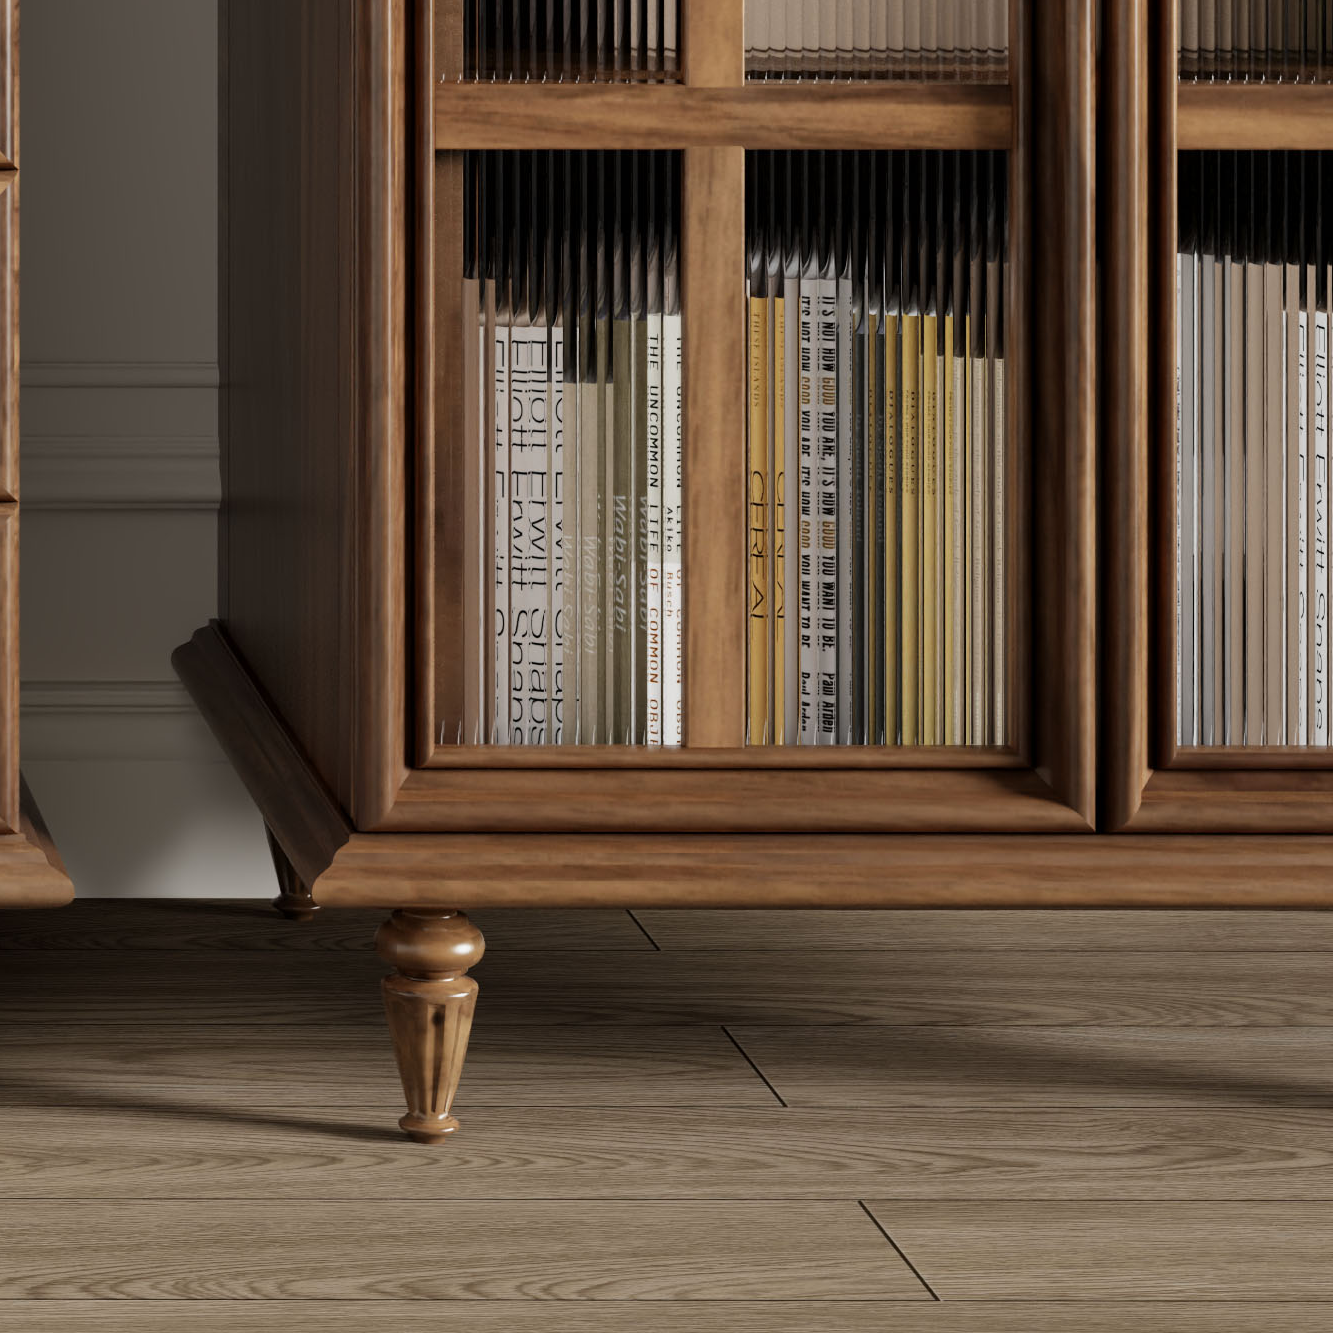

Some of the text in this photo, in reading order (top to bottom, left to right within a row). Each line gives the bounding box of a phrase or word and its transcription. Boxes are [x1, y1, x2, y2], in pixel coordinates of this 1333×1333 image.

[650, 334, 659, 371] THE
[650, 386, 659, 488] UNCOMMON
[650, 505, 659, 553] LIFE
[820, 296, 835, 733] IT'S NOT HOW GOOD YOU ARE, IT'S HOW GOOD YOU WANT TO BE. Paul Arden
[615, 495, 627, 633] Wabi-Sabi
[650, 568, 659, 593] OF
[666, 507, 674, 617] Akiko Busch
[650, 607, 659, 684] COMMON
